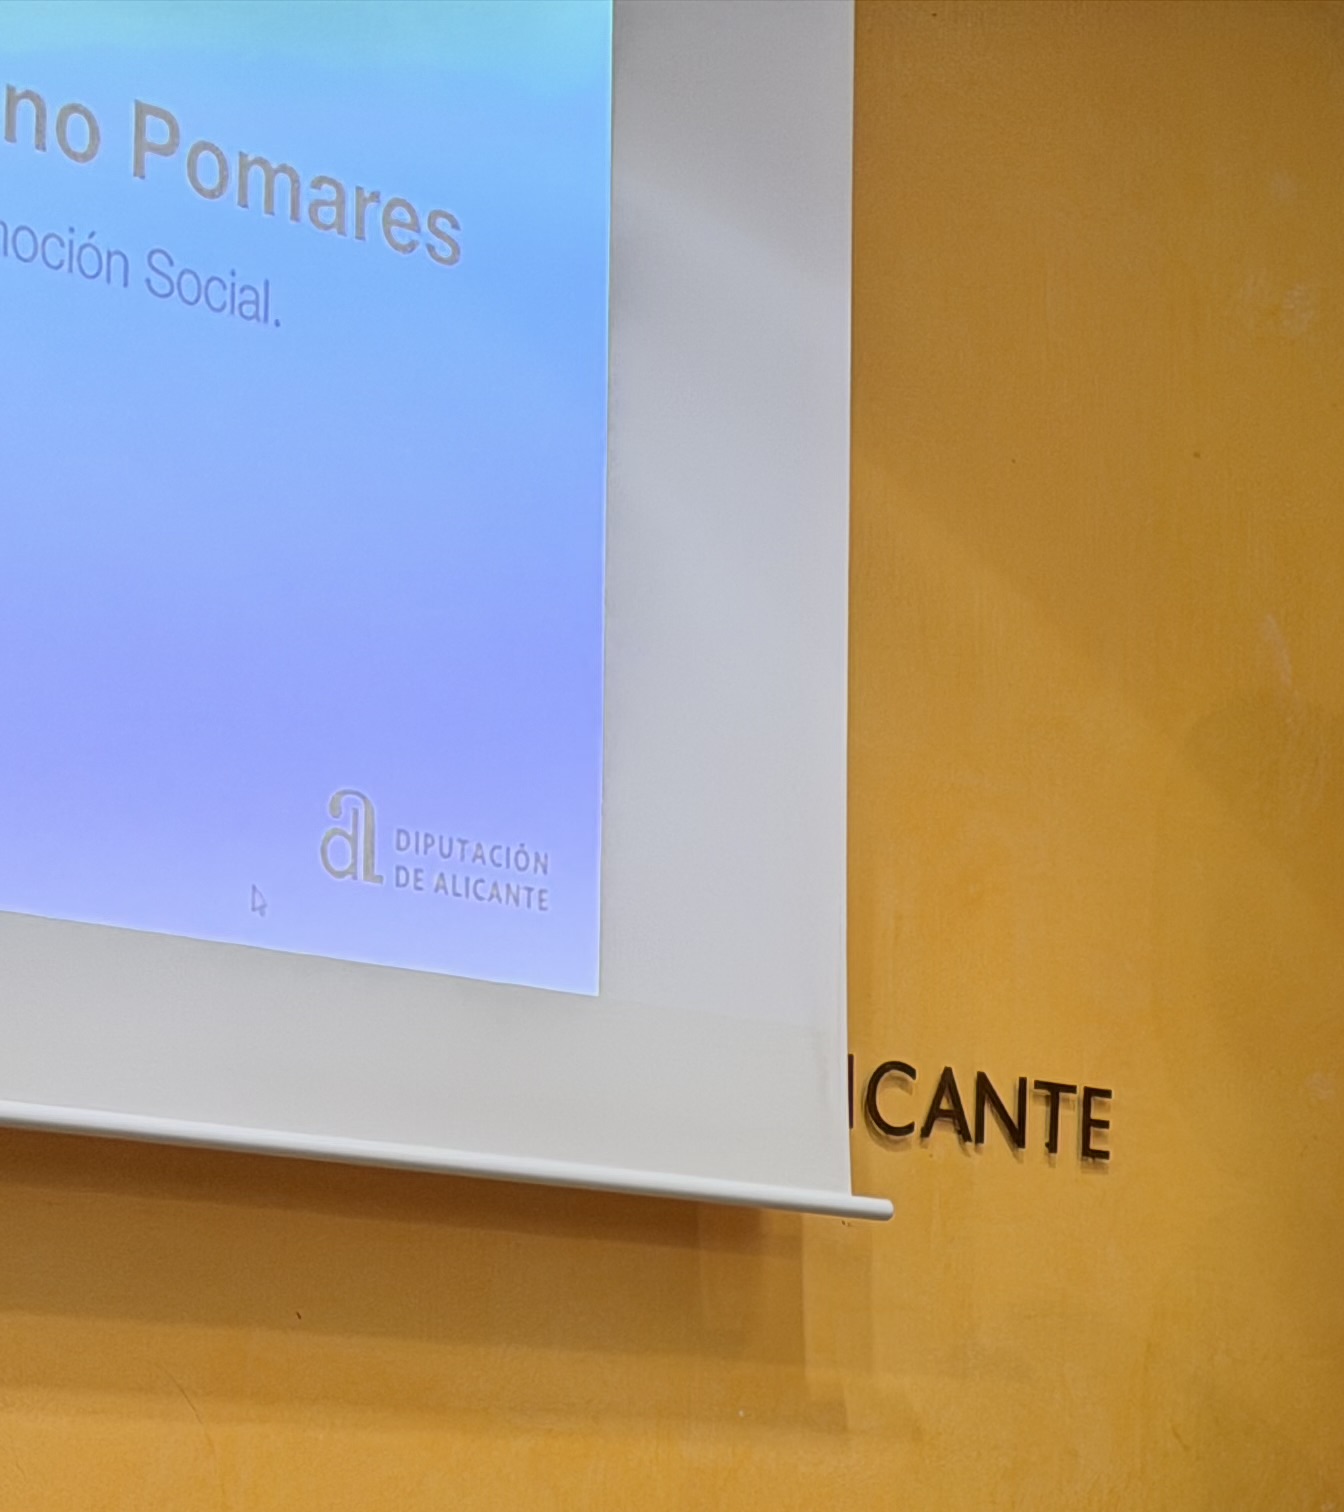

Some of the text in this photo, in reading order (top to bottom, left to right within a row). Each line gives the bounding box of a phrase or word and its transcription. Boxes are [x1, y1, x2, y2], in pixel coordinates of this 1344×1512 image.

[3, 83, 461, 267] no Pomares
[0, 220, 281, 328] oción Social.
[395, 827, 549, 876] DIPUTACIÓN
[395, 864, 549, 911] DE ALICANTE
